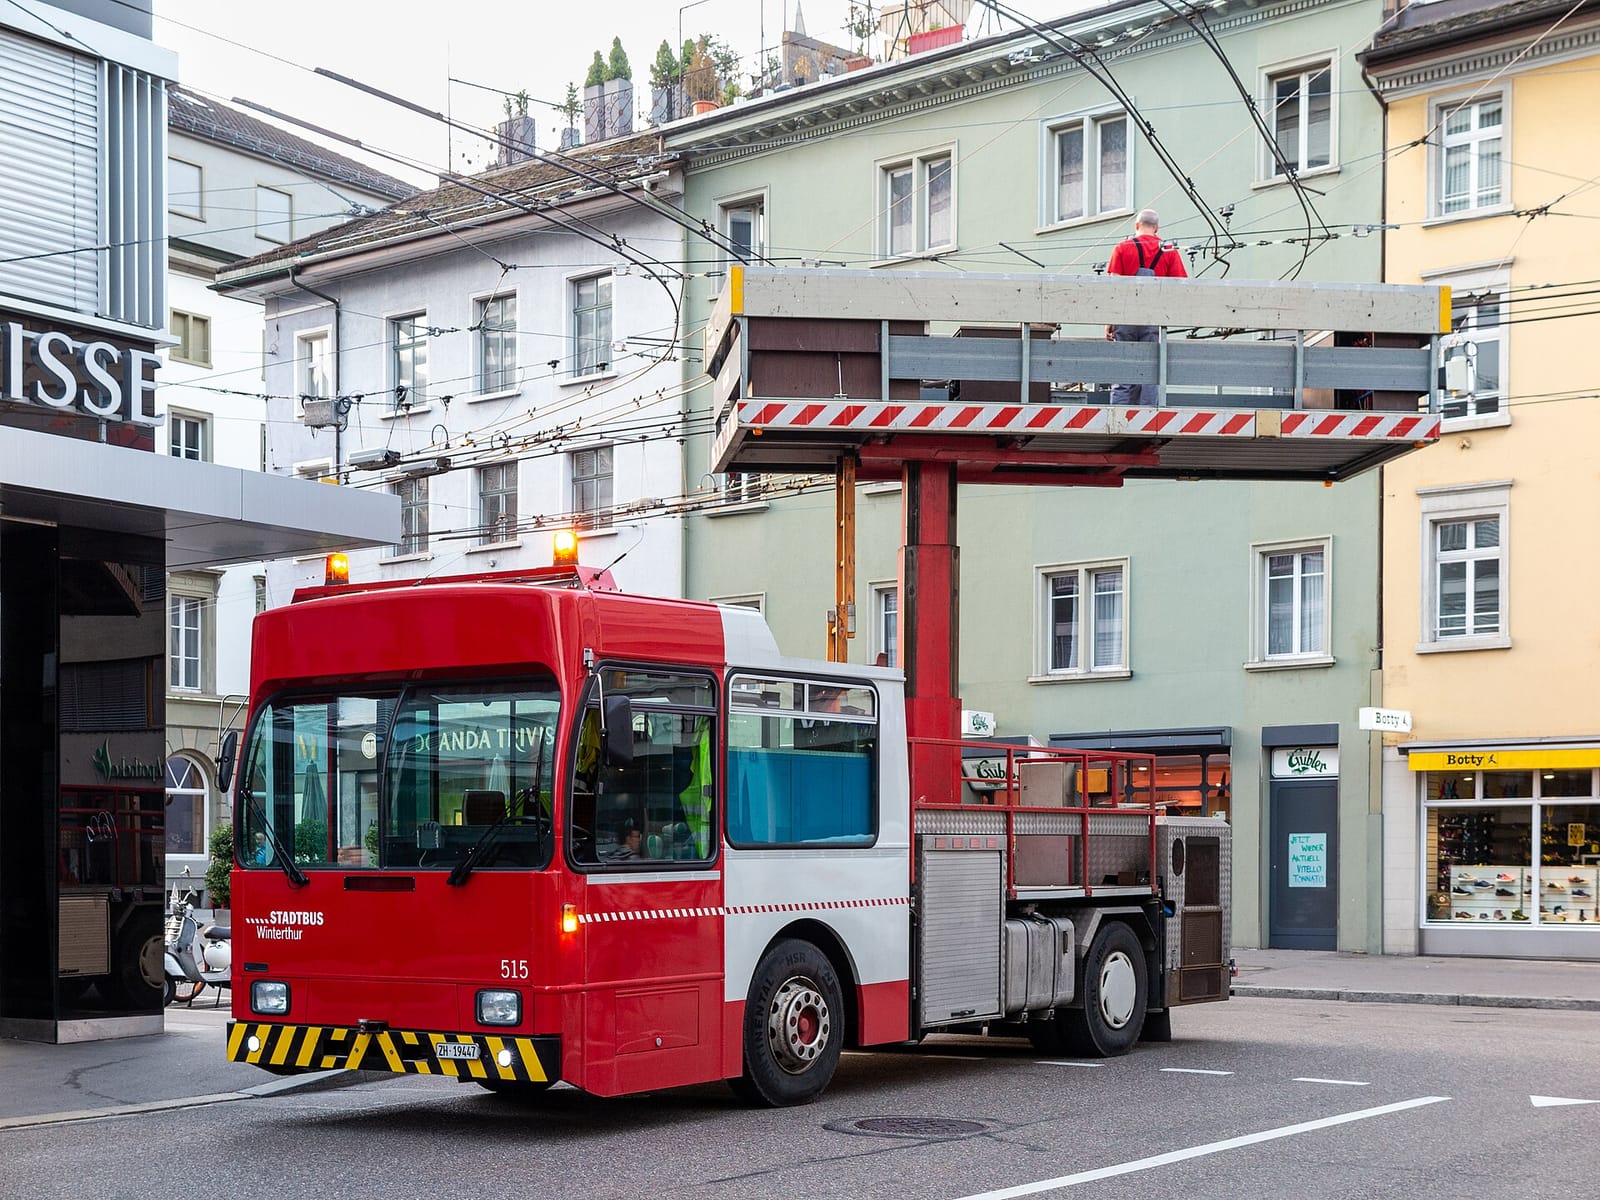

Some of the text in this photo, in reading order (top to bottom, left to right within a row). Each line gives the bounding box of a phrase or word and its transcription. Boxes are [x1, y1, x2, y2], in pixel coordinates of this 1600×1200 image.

[1375, 712, 1400, 728] Botty
[1288, 748, 1327, 772] Gubler
[1447, 754, 1484, 767] Botty
[1301, 843, 1324, 852] WIEDER
[1291, 854, 1320, 863] AKTUELL
[1296, 864, 1322, 873] VITELLO
[1293, 874, 1324, 883] TONNATO
[270, 911, 324, 926] STADTBUS
[256, 925, 303, 940] Winterthur
[501, 959, 529, 979] 515
